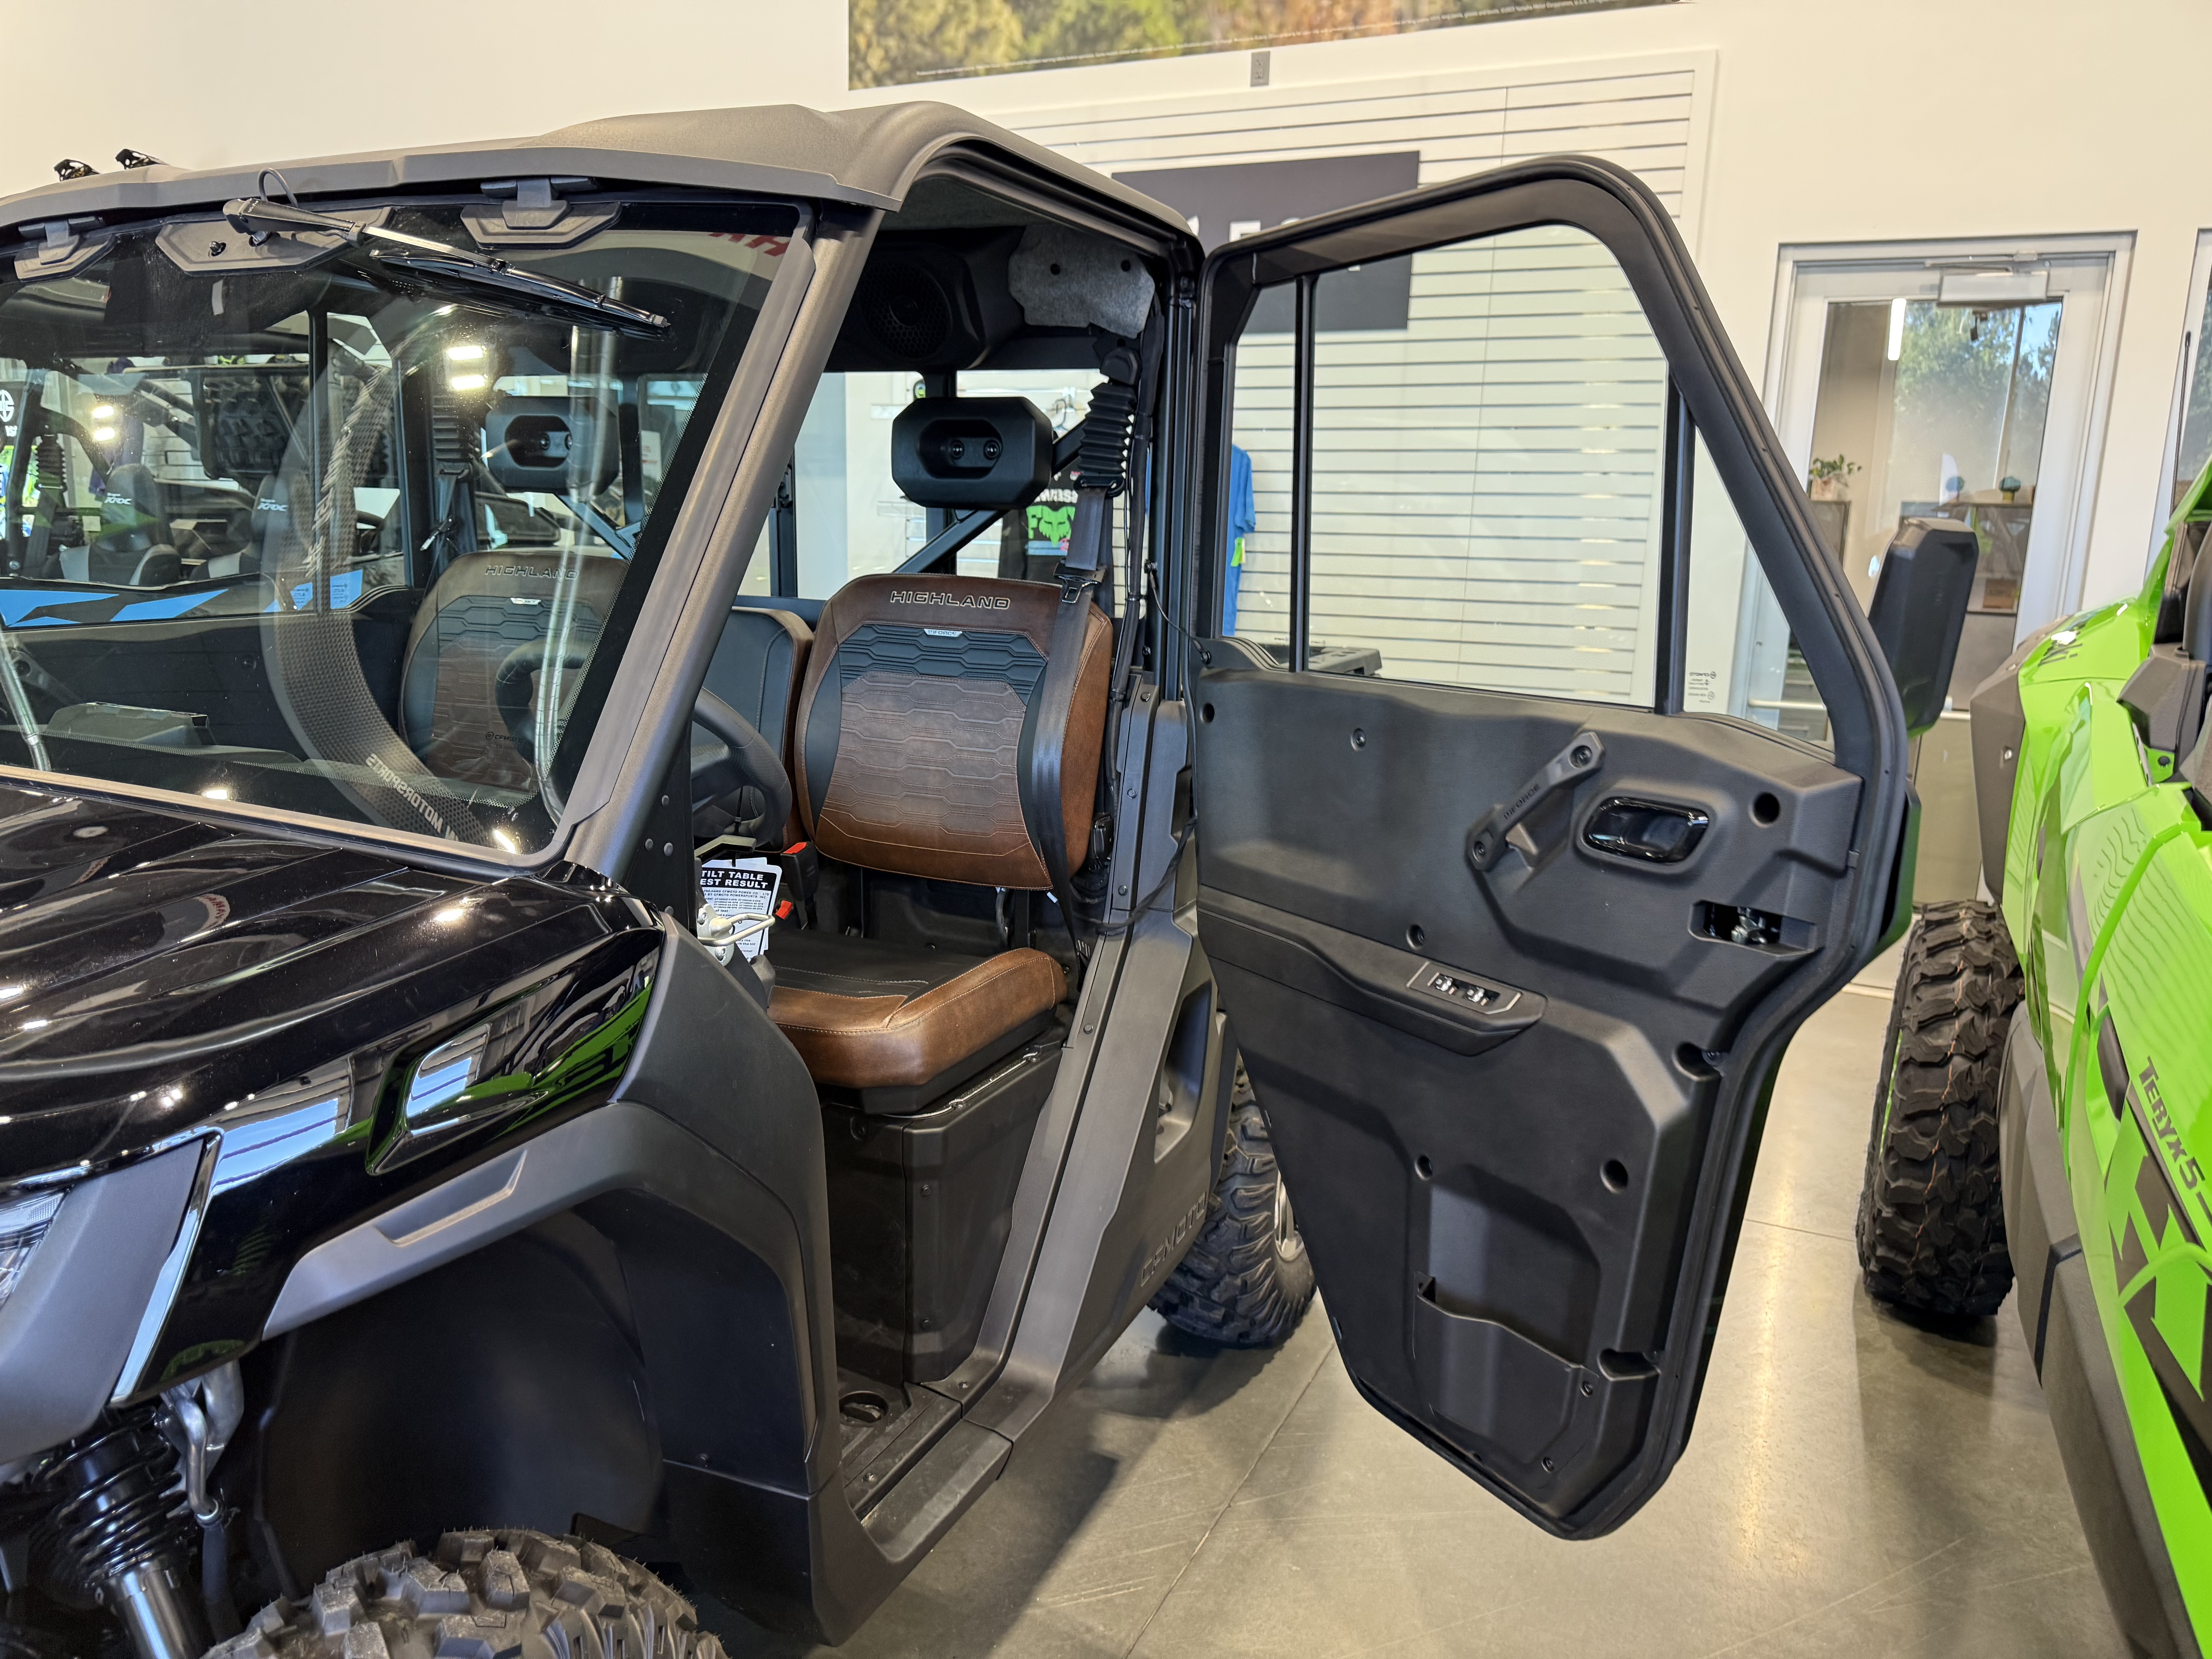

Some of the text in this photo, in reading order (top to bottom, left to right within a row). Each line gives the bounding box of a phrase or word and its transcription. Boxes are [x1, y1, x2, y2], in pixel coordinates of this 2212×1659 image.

[485, 565, 579, 580] HIGHLAND
[890, 591, 1011, 610] HIGHLAND
[725, 879, 768, 888] RESULT
[728, 872, 764, 881] TABLE
[1141, 1191, 1206, 1286] CFMOTO
